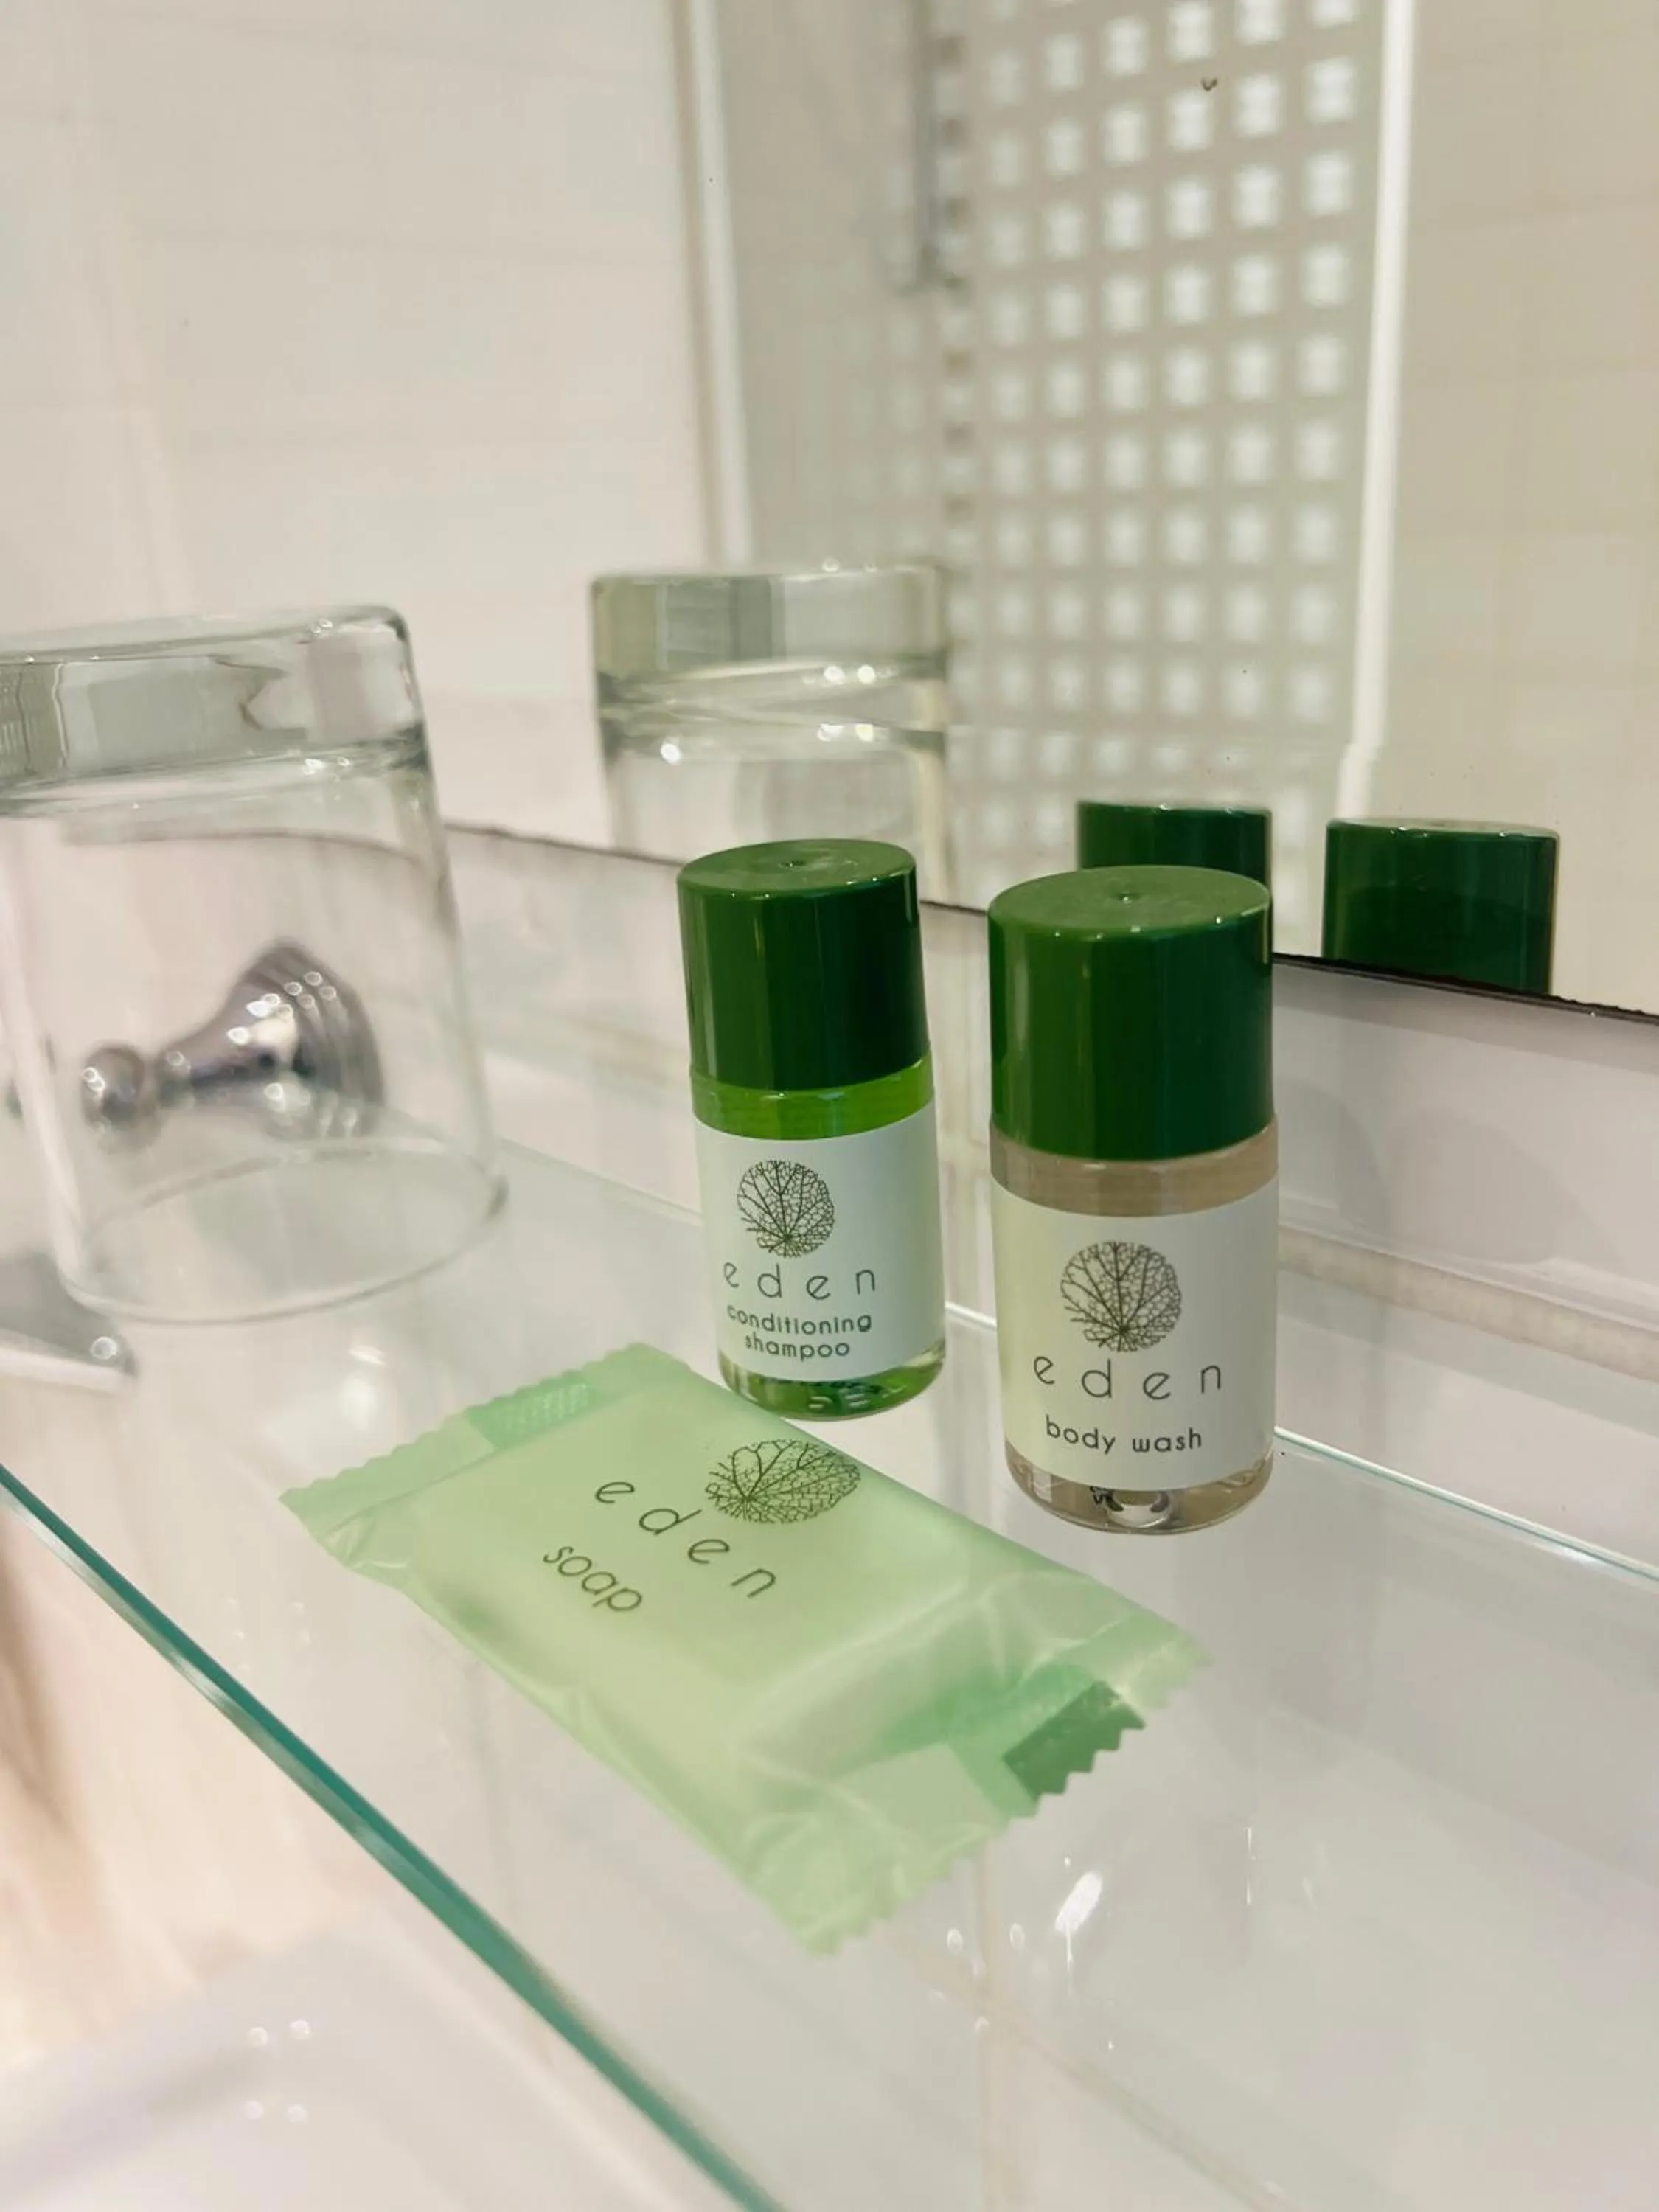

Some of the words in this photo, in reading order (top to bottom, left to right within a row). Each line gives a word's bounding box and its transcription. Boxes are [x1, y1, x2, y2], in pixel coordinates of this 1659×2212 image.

[723, 1262, 876, 1300] eden
[726, 1304, 872, 1335] conditioning
[745, 1332, 851, 1361] shampoo
[1033, 1356, 1222, 1400] eden
[1046, 1414, 1116, 1454] body
[1132, 1427, 1203, 1453] wash
[594, 1481, 776, 1598] eden
[543, 1546, 642, 1612] soap
